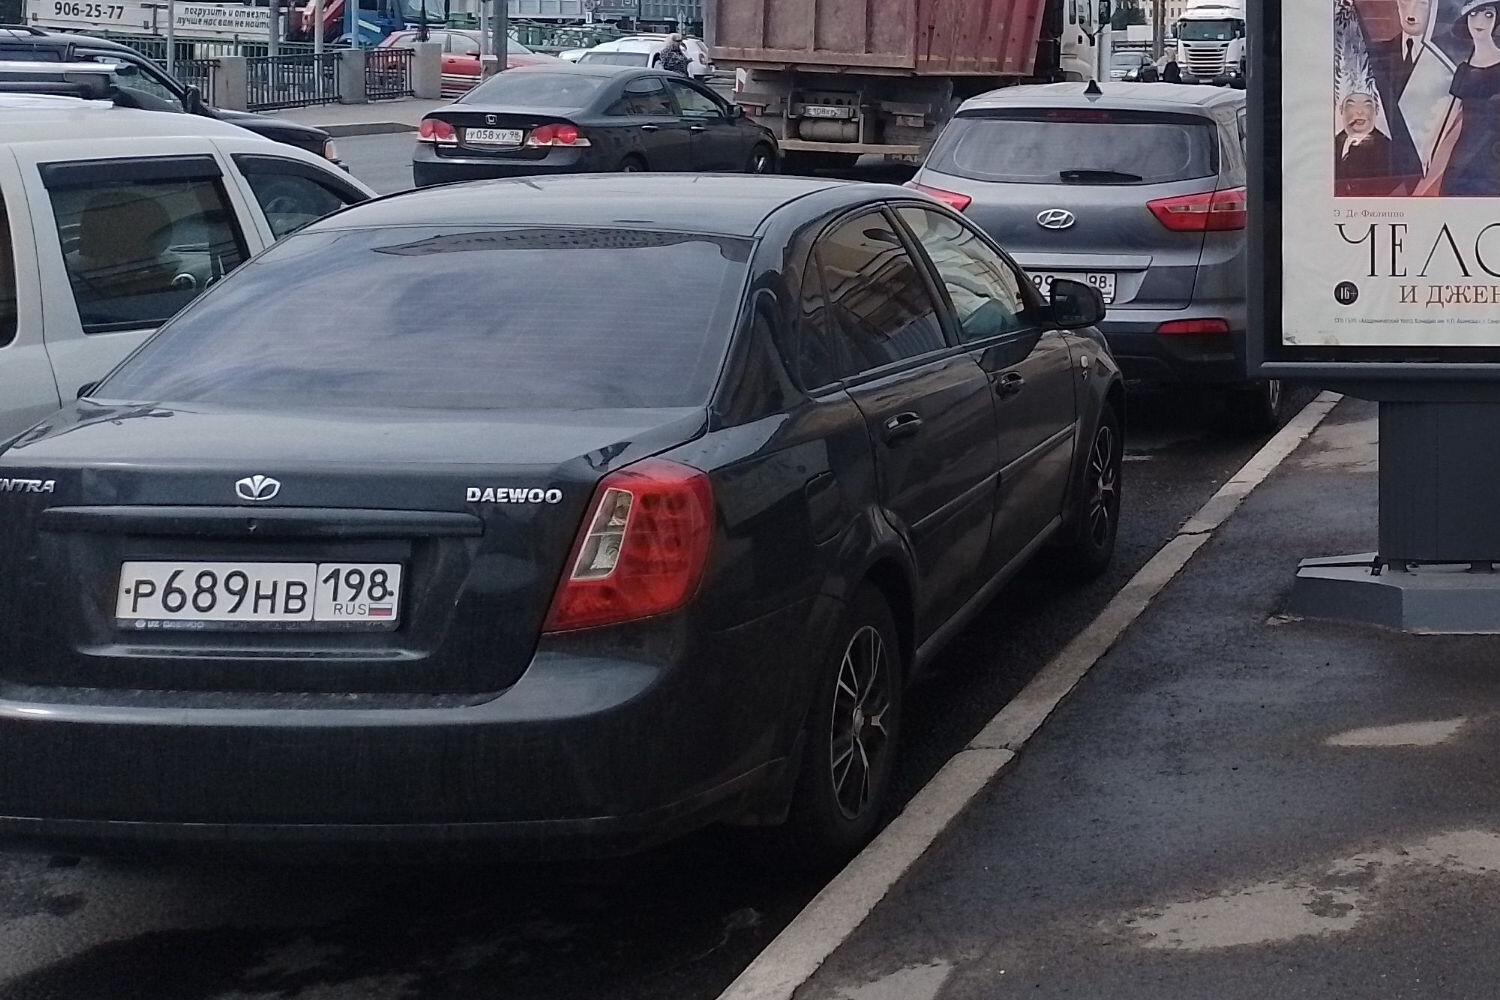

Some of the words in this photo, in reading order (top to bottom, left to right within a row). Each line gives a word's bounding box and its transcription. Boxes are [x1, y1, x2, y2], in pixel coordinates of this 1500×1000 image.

[54, 1, 124, 20] 906-25-77
[184, 7, 227, 18] погрузить
[228, 9, 234, 17] и
[176, 16, 202, 27] лучше
[203, 18, 217, 26] нас
[217, 19, 234, 27] вам
[234, 20, 244, 28] не
[1399, 284, 1418, 304] И
[0, 478, 57, 493] NTRA
[466, 487, 563, 504] DAEWOO
[131, 569, 308, 614] Р689НВ
[322, 567, 390, 602] 198
[333, 602, 367, 616] RUS
